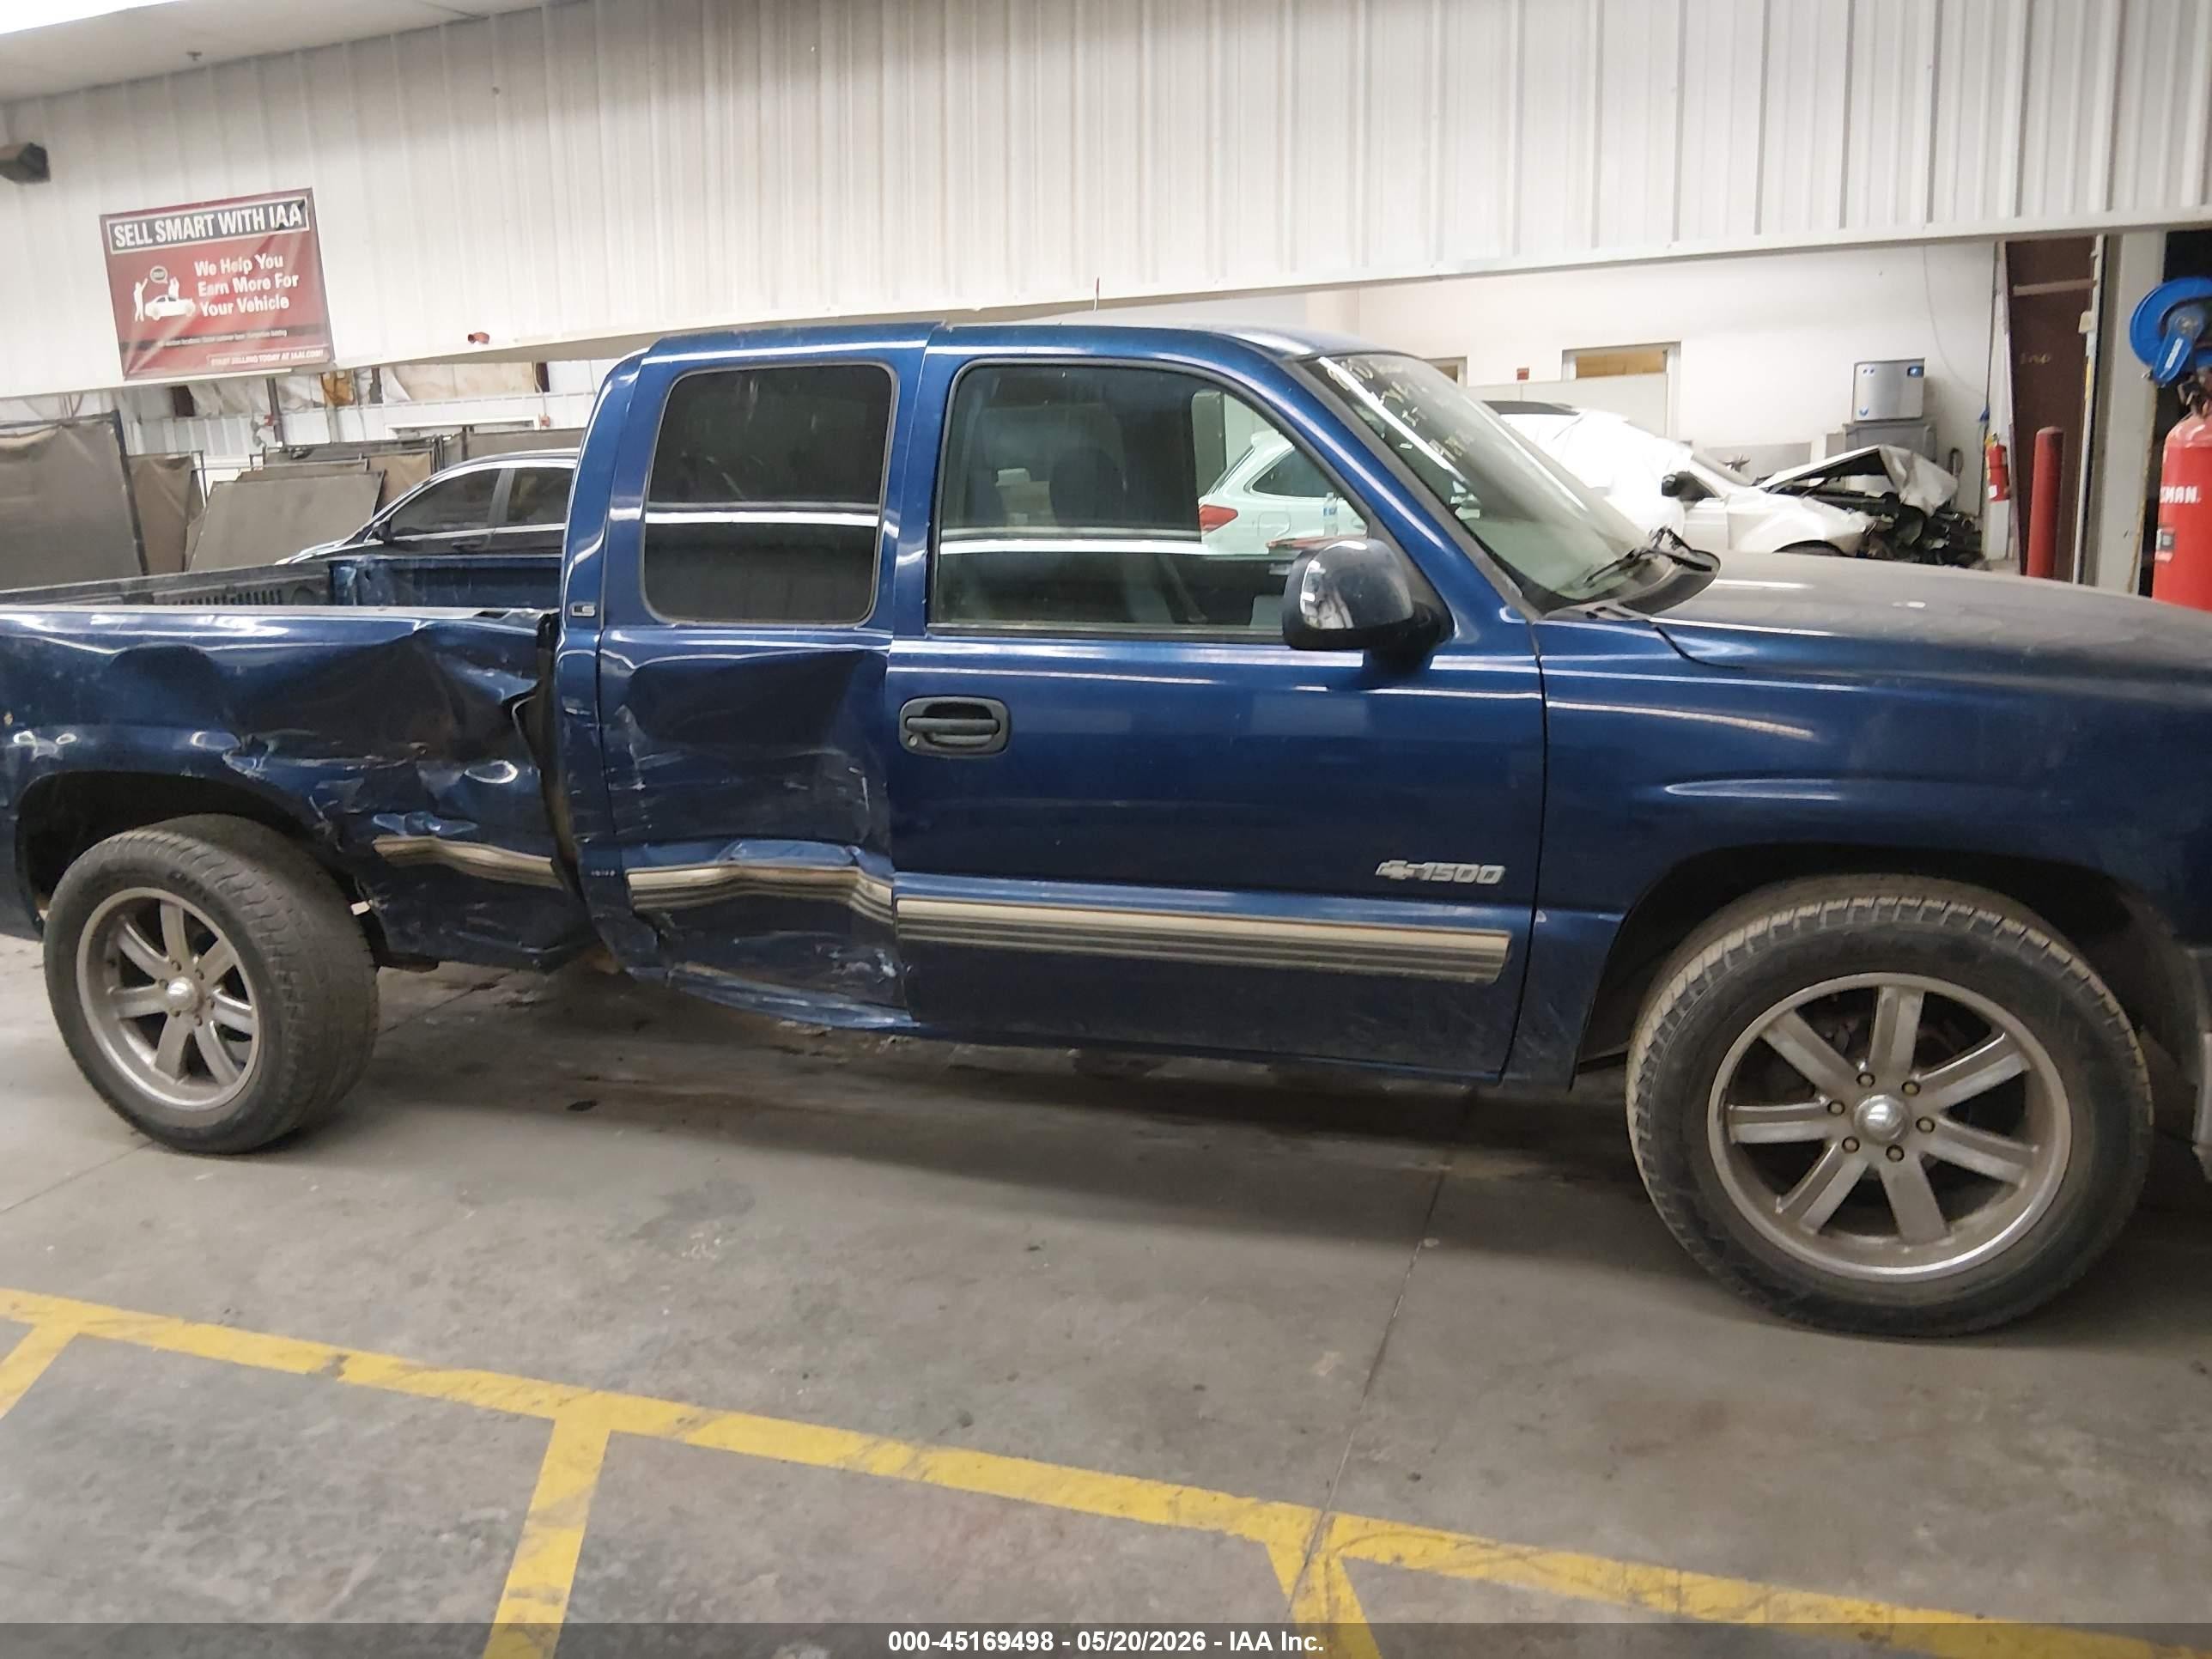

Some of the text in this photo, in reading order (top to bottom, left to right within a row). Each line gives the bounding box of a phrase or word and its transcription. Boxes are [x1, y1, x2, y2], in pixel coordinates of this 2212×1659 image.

[114, 204, 302, 247] SELL SMART WITH IAA
[194, 252, 283, 276] We Help You
[198, 272, 299, 296] Earn More For
[199, 294, 289, 317] Your Vehicle
[1420, 862, 1504, 884] 1500
